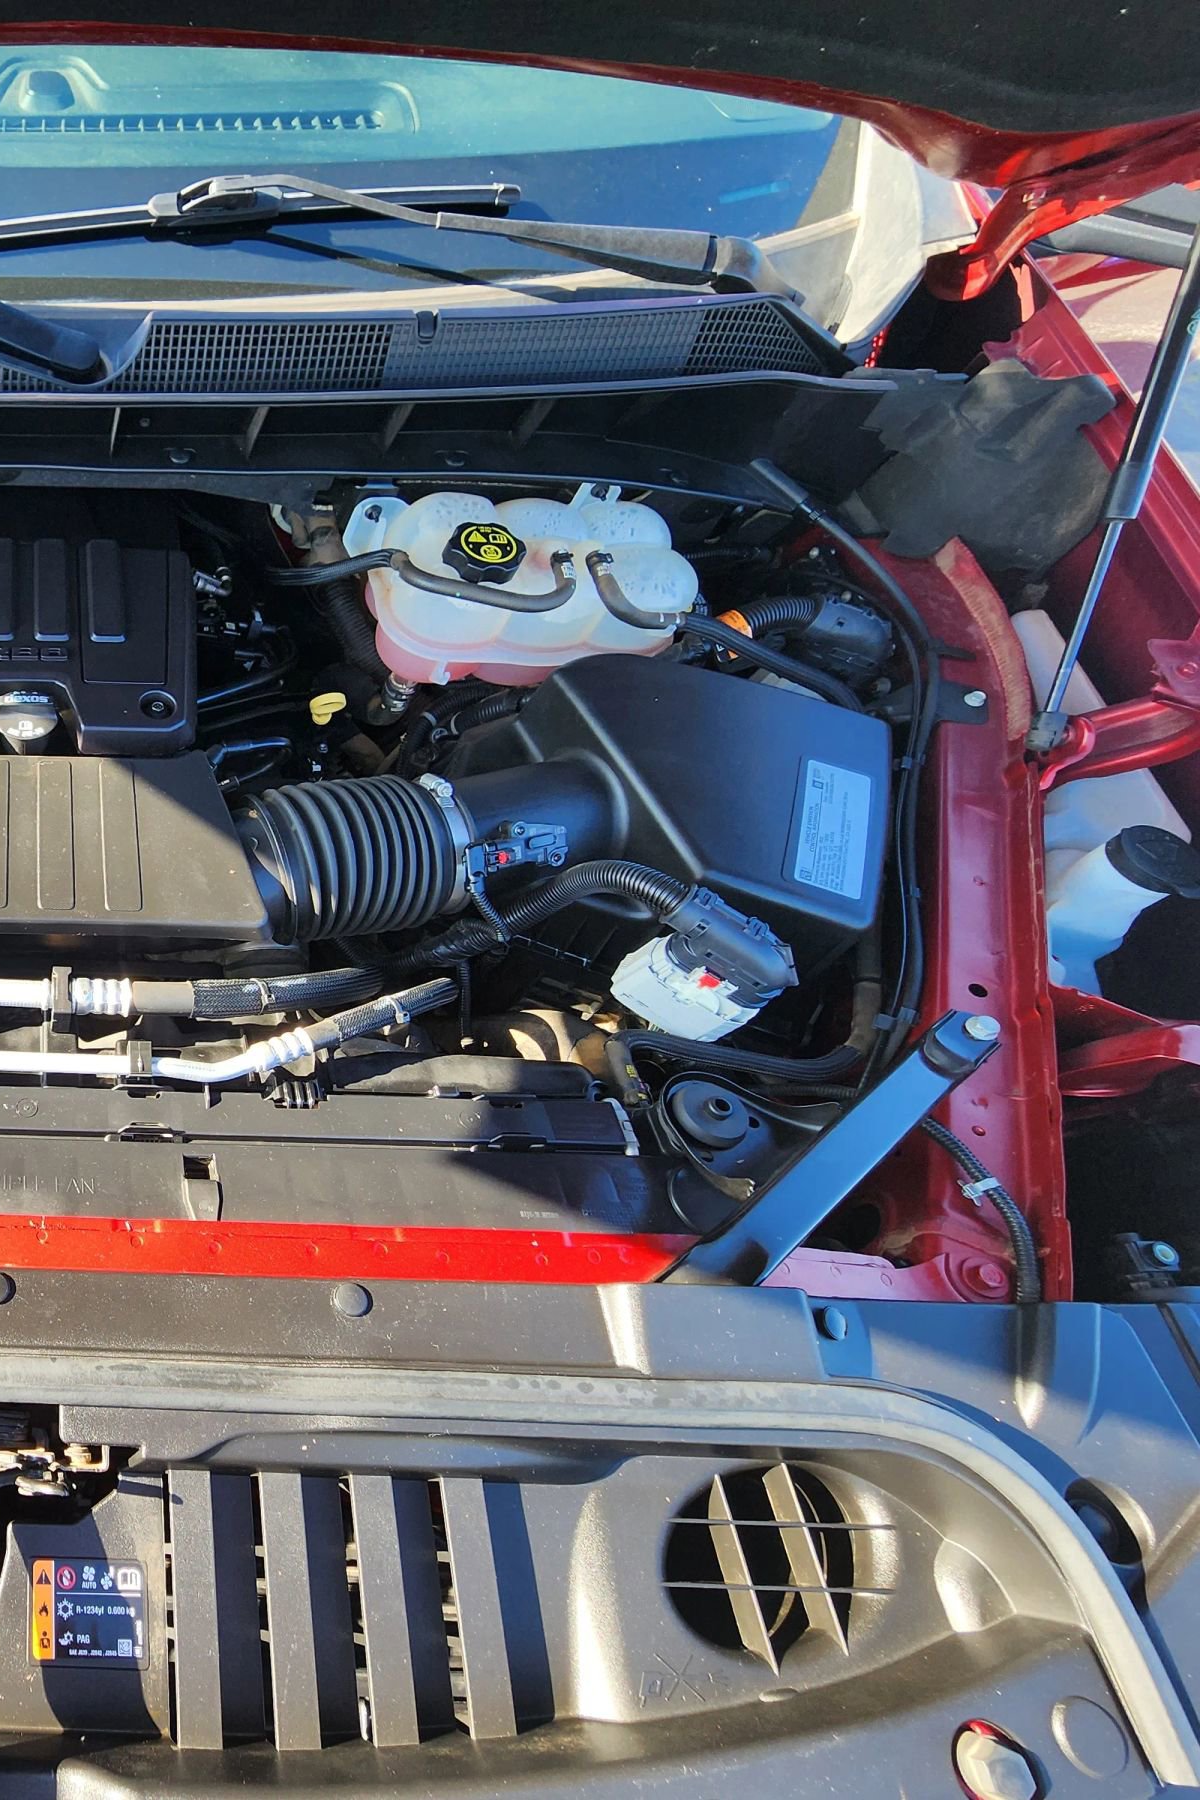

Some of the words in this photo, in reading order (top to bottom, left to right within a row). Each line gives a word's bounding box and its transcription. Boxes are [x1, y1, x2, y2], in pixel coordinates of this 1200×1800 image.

[4, 693, 49, 703] dexos
[55, 1174, 96, 1195] FAN
[82, 1581, 97, 1590] AUTO
[76, 1605, 104, 1617] R-1234yf
[76, 1634, 90, 1644] PAG
